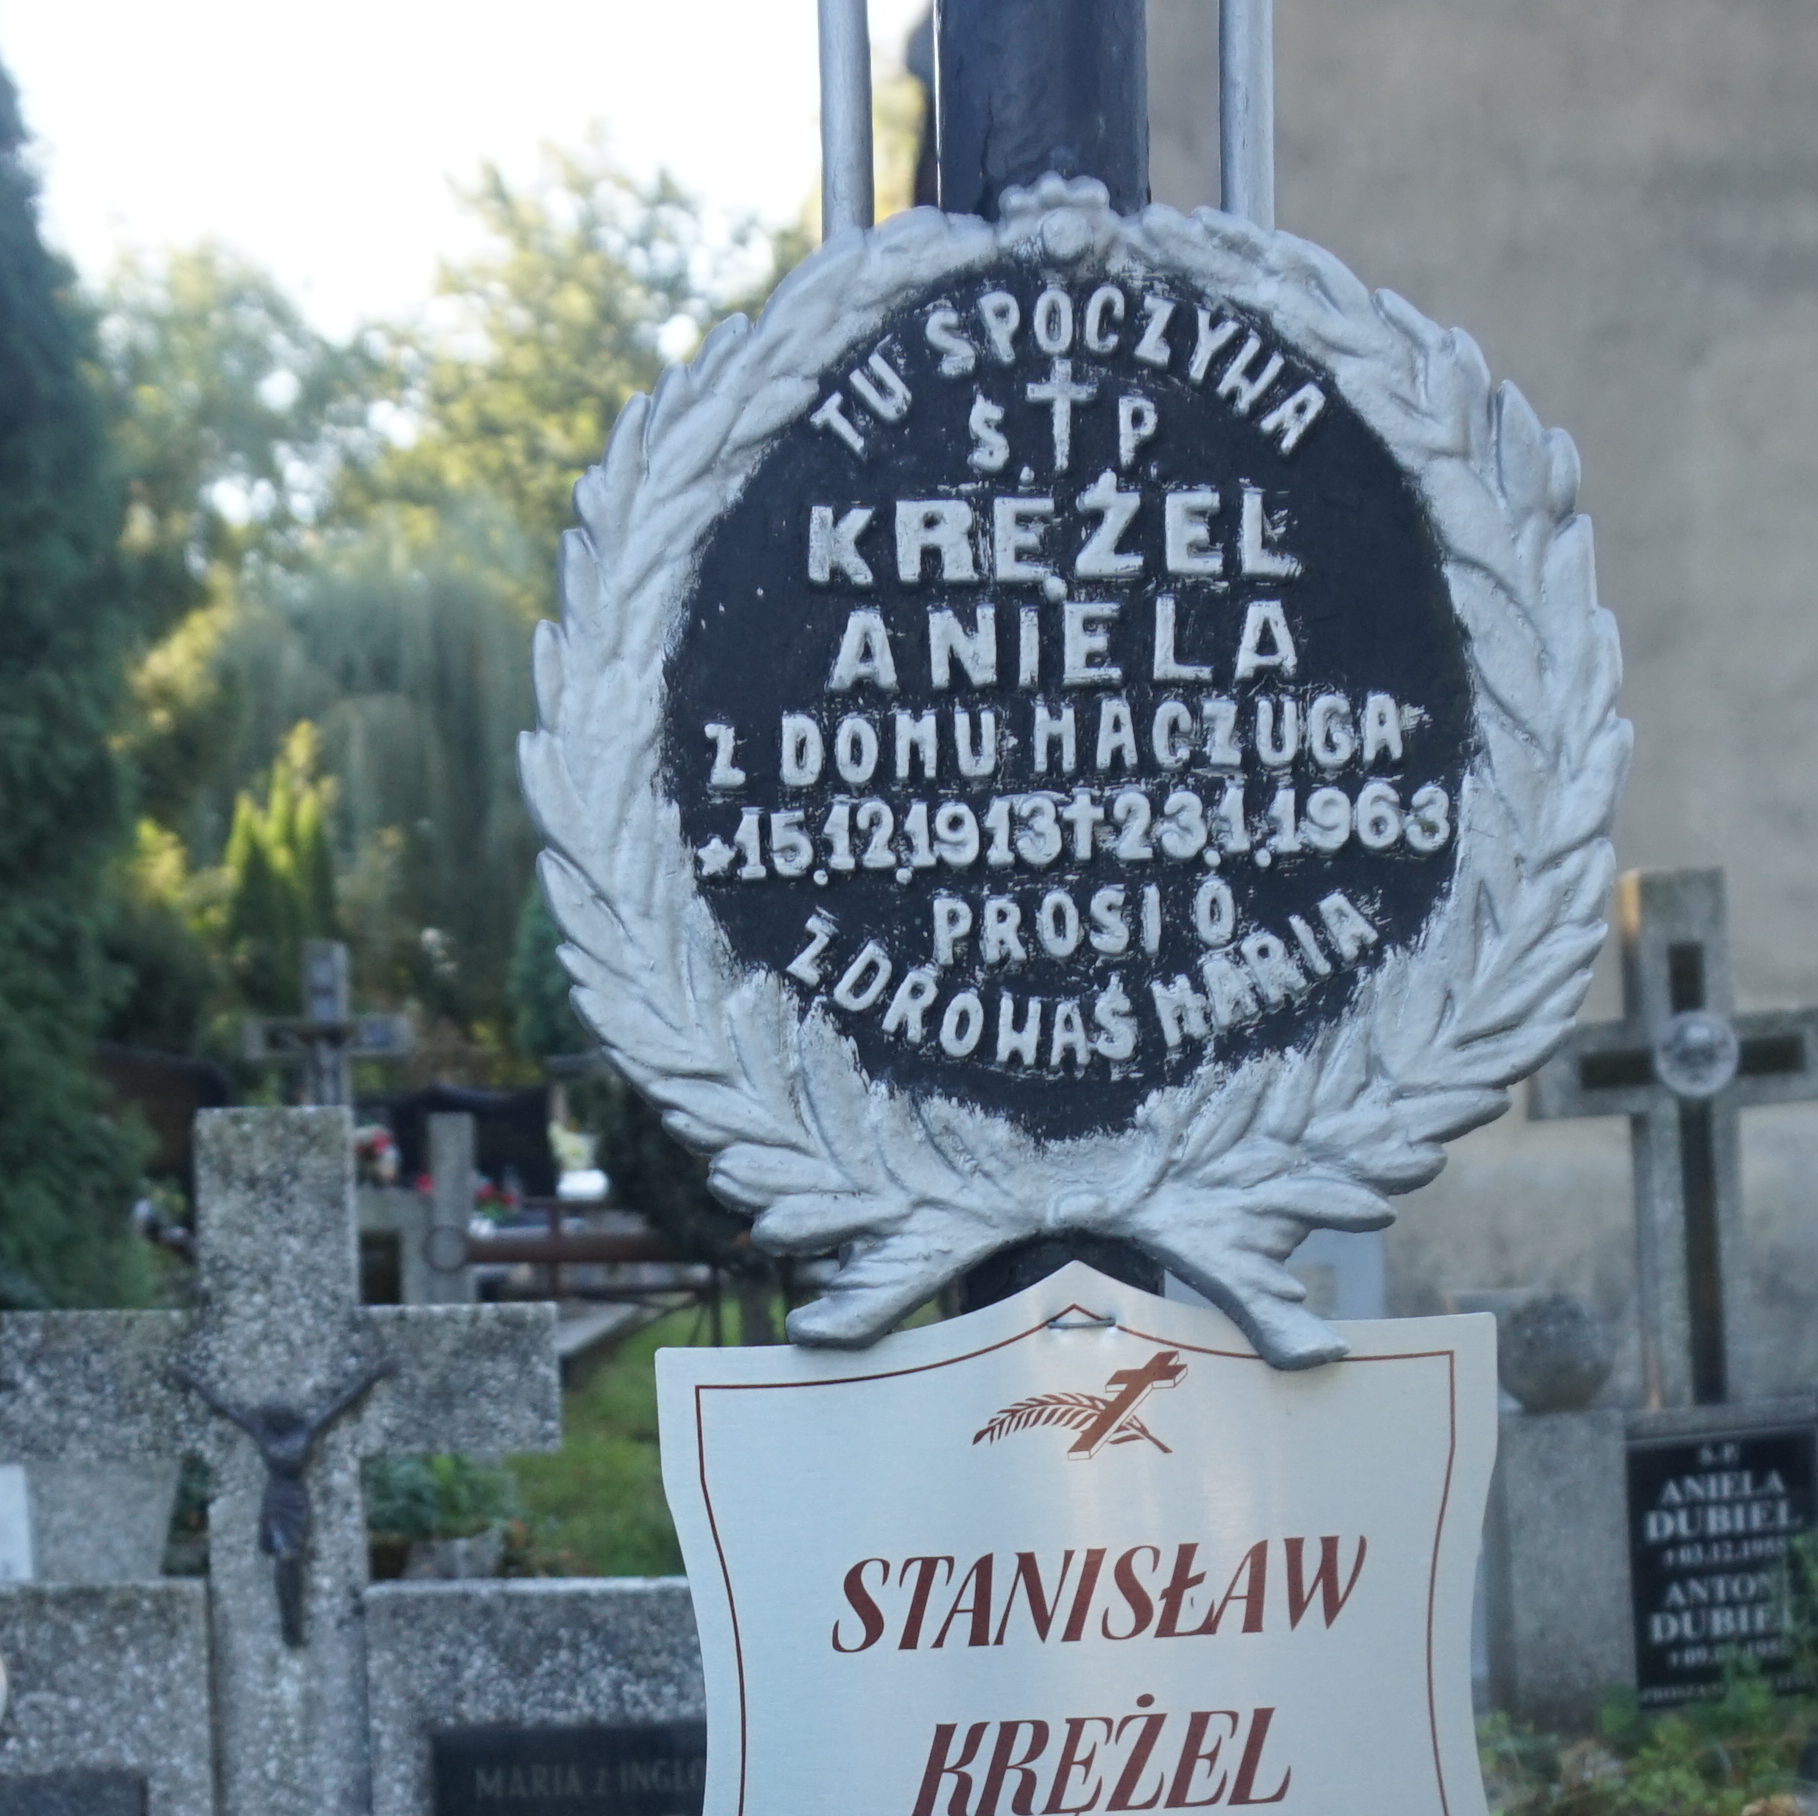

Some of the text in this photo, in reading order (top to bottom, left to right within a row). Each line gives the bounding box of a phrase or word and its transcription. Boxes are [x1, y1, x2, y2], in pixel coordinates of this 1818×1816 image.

[809, 284, 1327, 460] TU SPOCZYWA
[827, 597, 1299, 692] ANIELA
[704, 693, 1404, 787] Z DOMU MACZUGA
[933, 879, 1237, 966] PROSI O
[1151, 892, 1379, 1049] MARIA
[1644, 1500, 1803, 1544] DUBIEL
[1659, 1470, 1786, 1505] ANIELA
[831, 1534, 1368, 1653] STANISŁAW
[475, 1761, 584, 1799] MARIA
